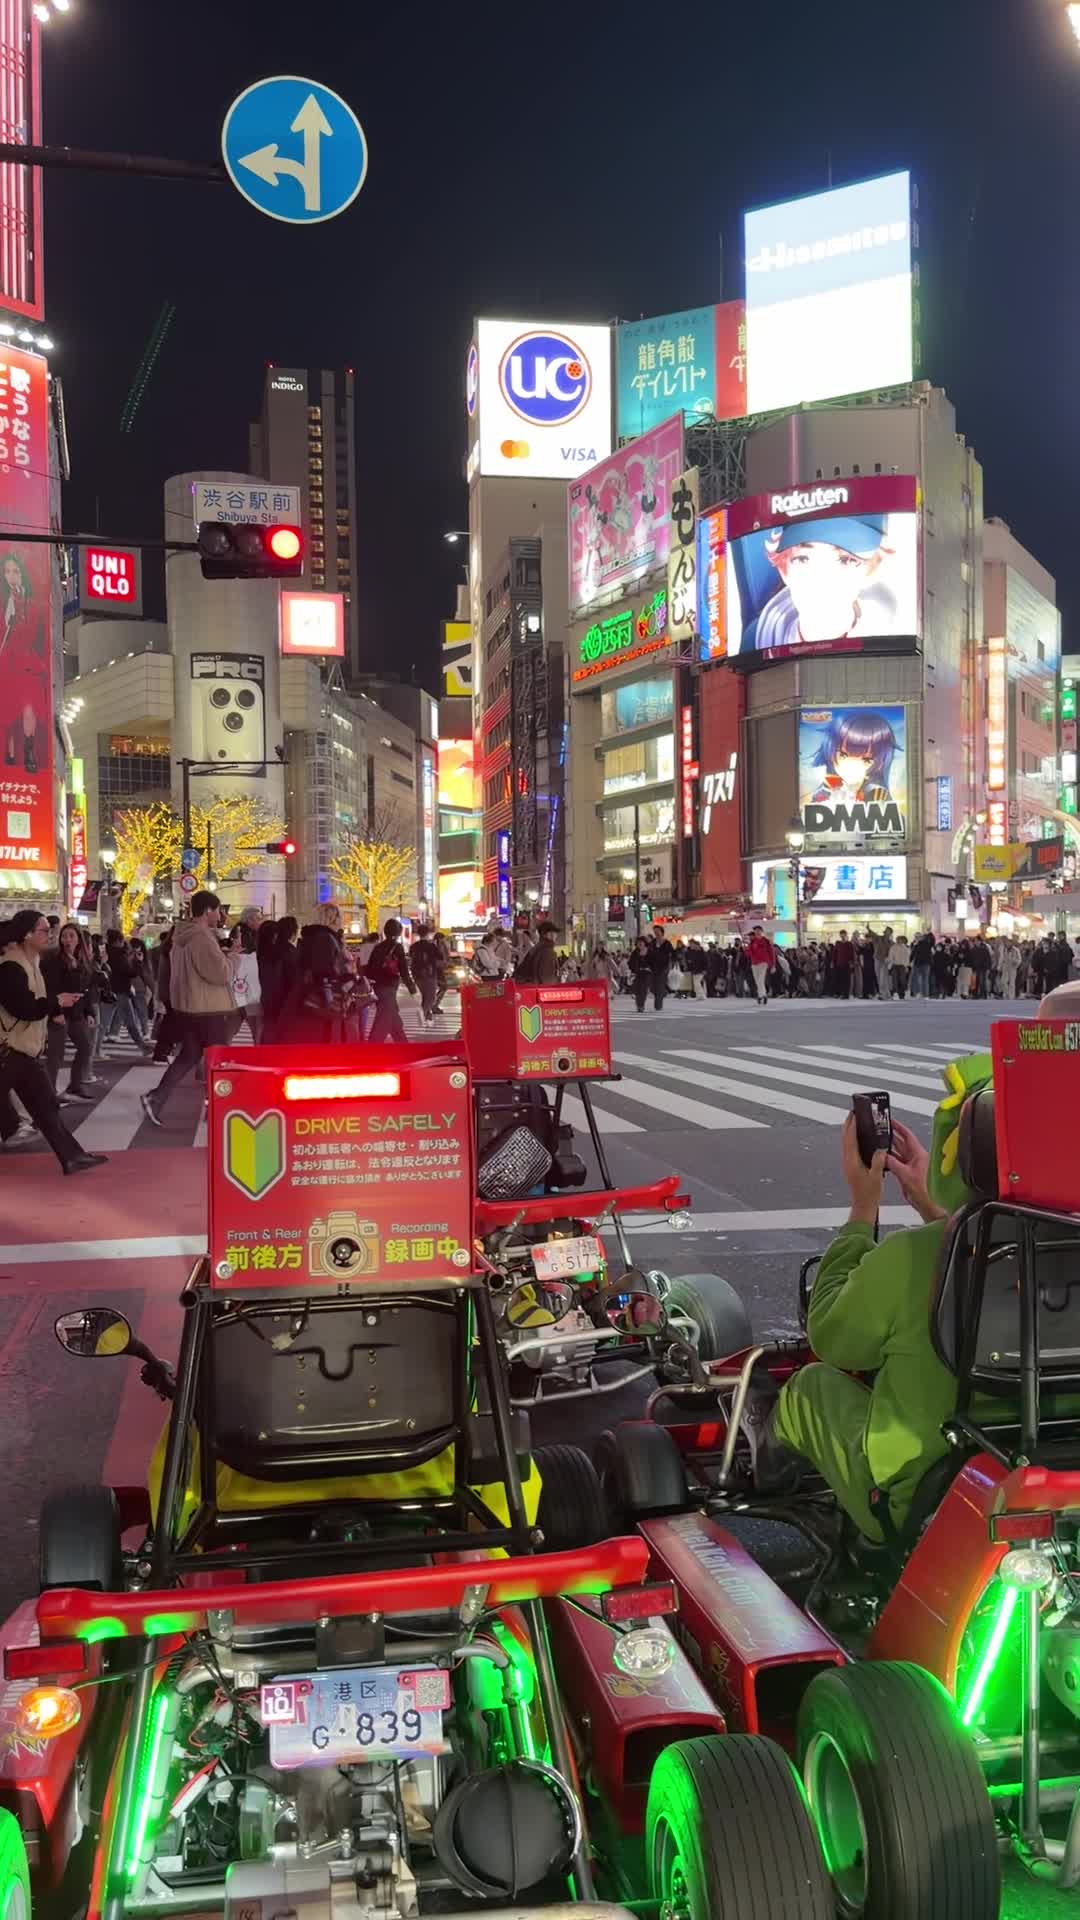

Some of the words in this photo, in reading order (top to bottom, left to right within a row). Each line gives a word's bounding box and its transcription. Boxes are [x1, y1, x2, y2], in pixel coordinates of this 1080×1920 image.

[638, 334, 696, 371] 龍角散
[271, 381, 304, 391] INDIGO
[508, 354, 584, 402] UC
[630, 364, 707, 401] ダイレクト
[560, 447, 598, 462] VISA
[203, 488, 291, 512] 渋谷駅前
[771, 486, 849, 516] Rakuten
[217, 511, 257, 525] Shibuya
[261, 512, 281, 524] Sta.
[91, 553, 127, 574] UNI
[669, 477, 697, 633] もんじゃ
[91, 574, 130, 596] QLO
[193, 661, 263, 680] PRO
[804, 801, 903, 833] DMM
[295, 1117, 361, 1135] DRIVE
[367, 1113, 456, 1133] SAFELY
[227, 1230, 258, 1241] Front
[262, 1231, 271, 1240] &
[275, 1228, 303, 1239] Rear
[391, 1222, 449, 1234] Recording
[226, 1243, 304, 1270] 前後方
[384, 1236, 460, 1264] 録画中
[333, 1680, 377, 1701] 港区
[264, 1696, 290, 1715] 10
[312, 1725, 330, 1750] G
